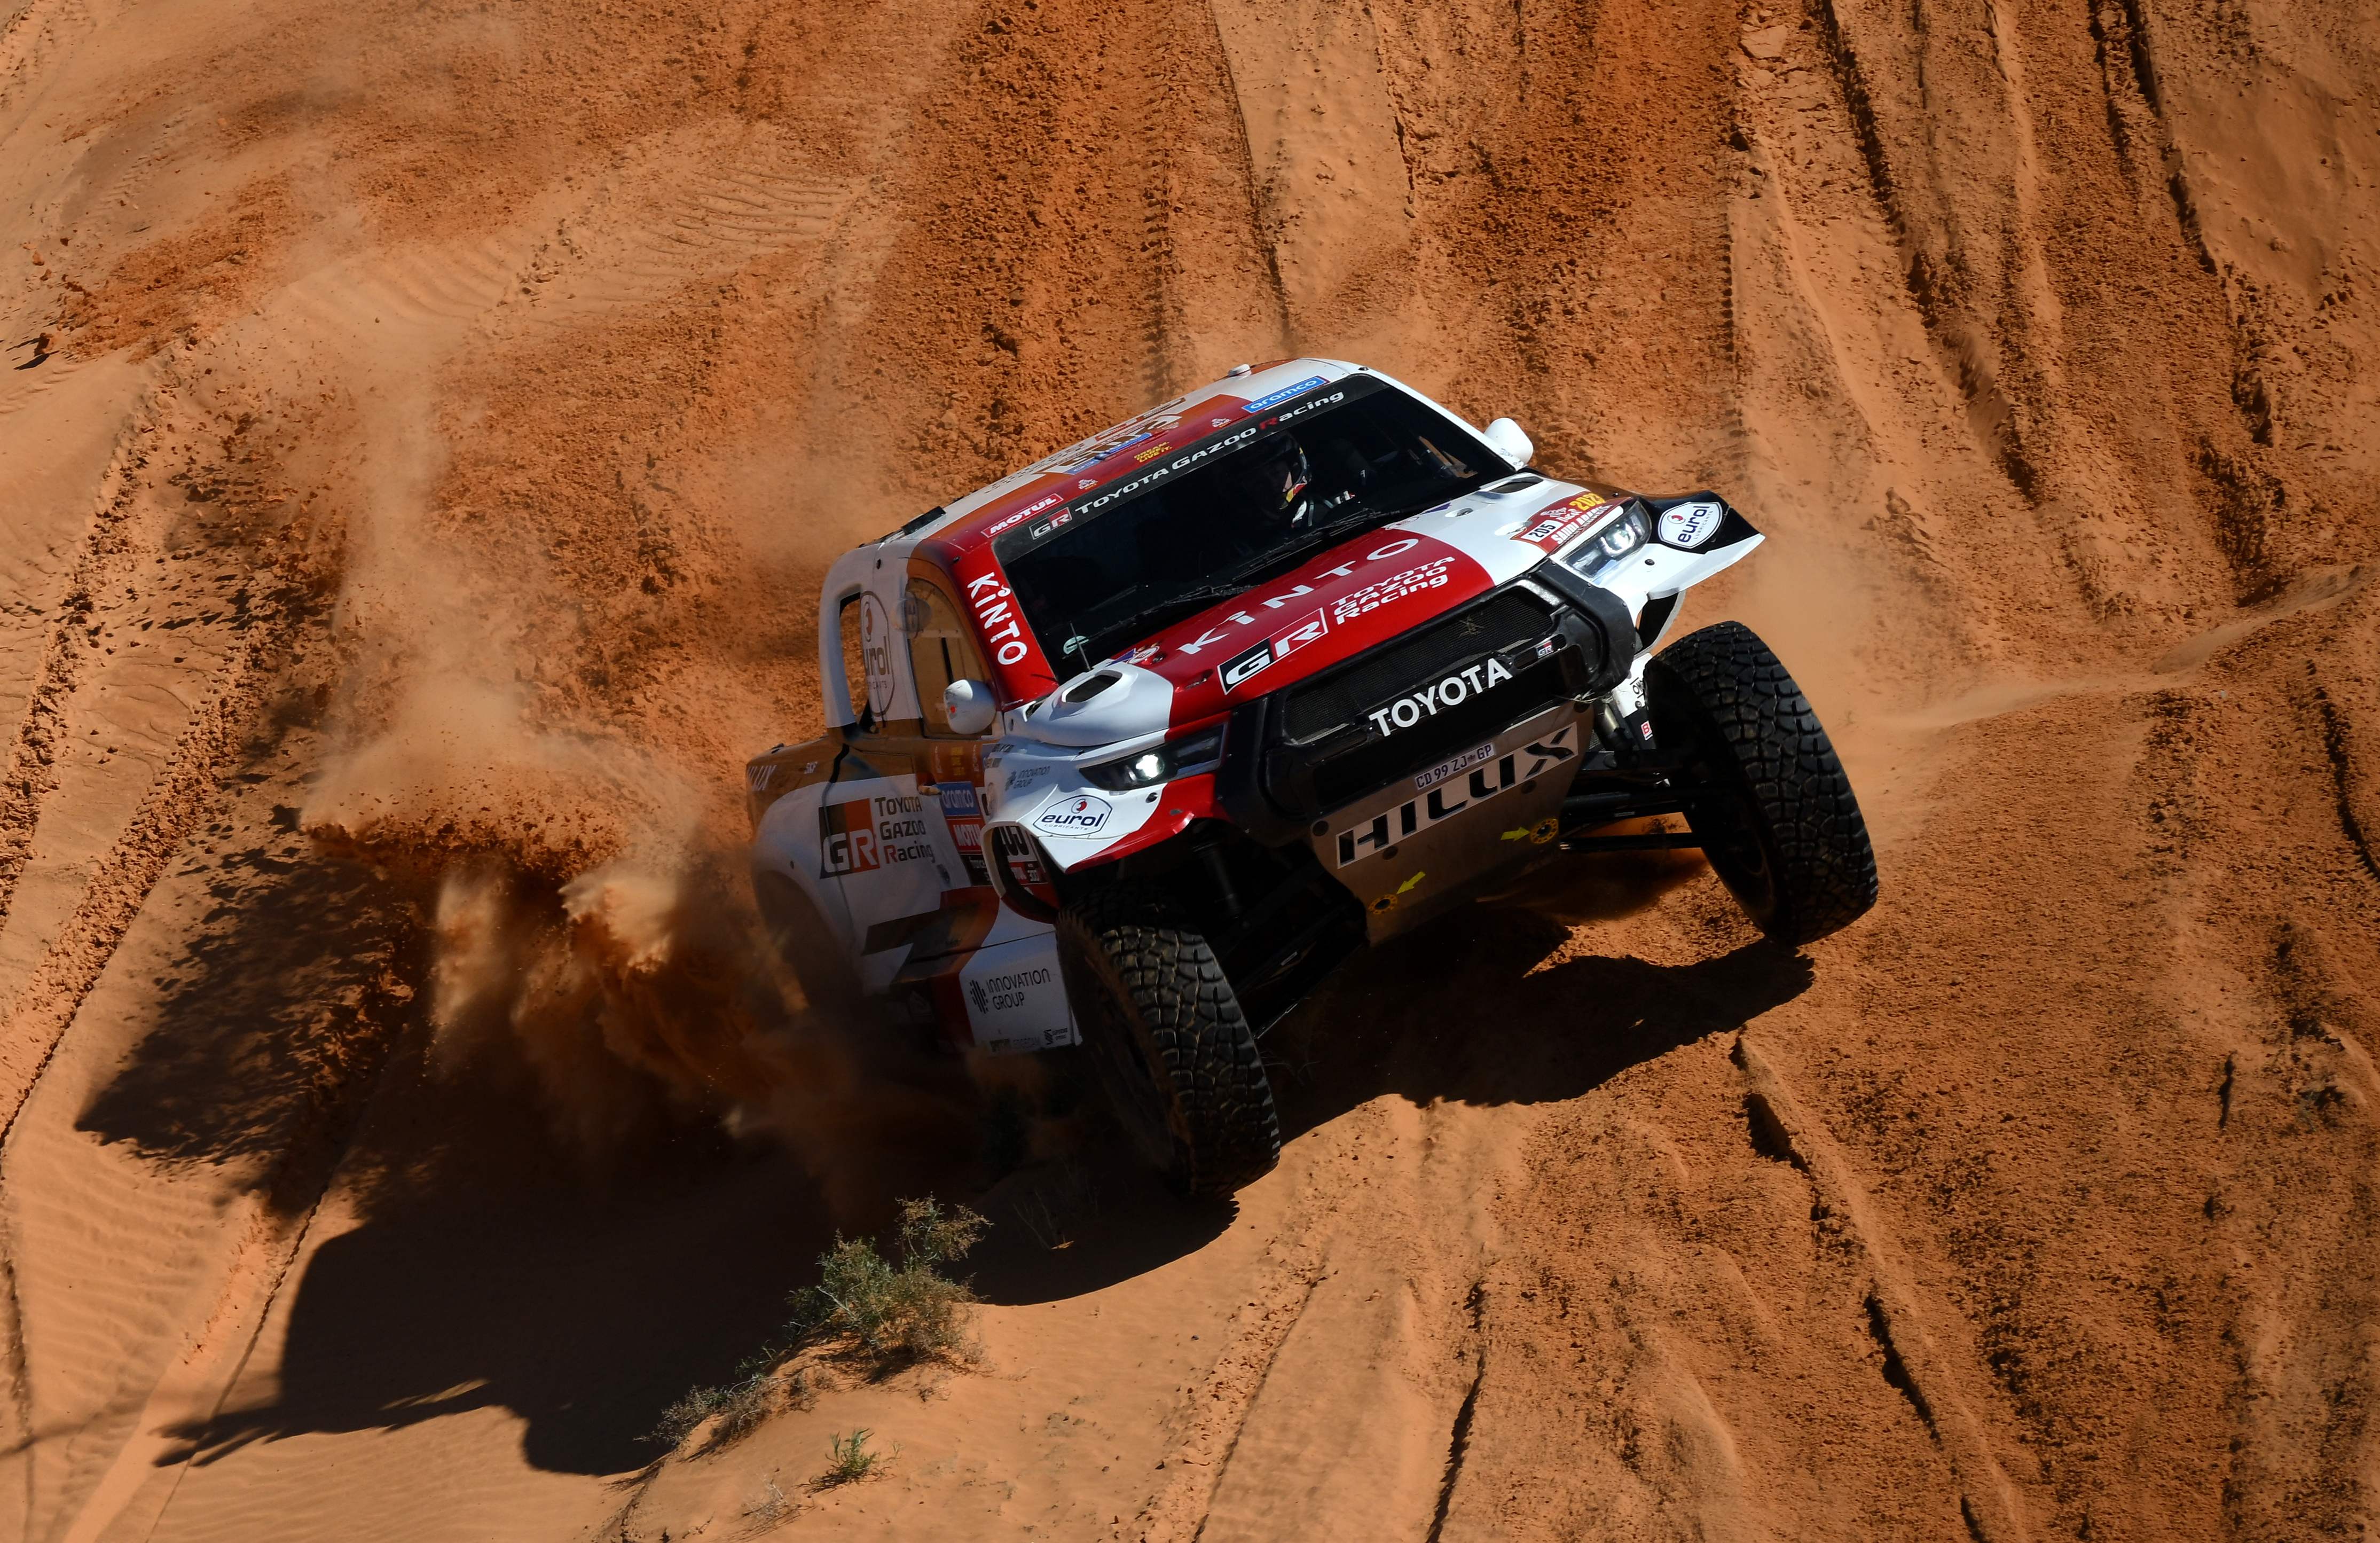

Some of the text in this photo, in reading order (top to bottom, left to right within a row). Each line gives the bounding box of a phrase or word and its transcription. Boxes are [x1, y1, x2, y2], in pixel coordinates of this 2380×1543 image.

[1251, 379, 1317, 409] aramco
[1033, 513, 1070, 537] GR
[1075, 468, 1169, 514] TOYOTA
[1172, 427, 1256, 469] GAZOO
[1260, 391, 1344, 429] Racing
[990, 497, 1057, 534] MOTUL
[1529, 523, 1557, 538] 205
[1551, 521, 1579, 545] SAUDI
[1677, 506, 1710, 543] eurol
[1330, 557, 1455, 606] TOYOTA
[1334, 566, 1447, 615] GAZOO
[1336, 574, 1448, 625] Racing
[1226, 621, 1323, 685] GR
[1369, 658, 1512, 737] TOYOTA
[1416, 745, 1491, 788] CD 99 ZJ GP
[875, 796, 922, 816] TOYOTA
[941, 789, 975, 809] aramco
[1338, 726, 1575, 866] HILUX
[879, 820, 926, 841] GAZOO
[1041, 813, 1105, 827] eurol
[823, 828, 877, 873] GR
[884, 841, 936, 864] Racing
[992, 991, 1025, 1011] GROUP
